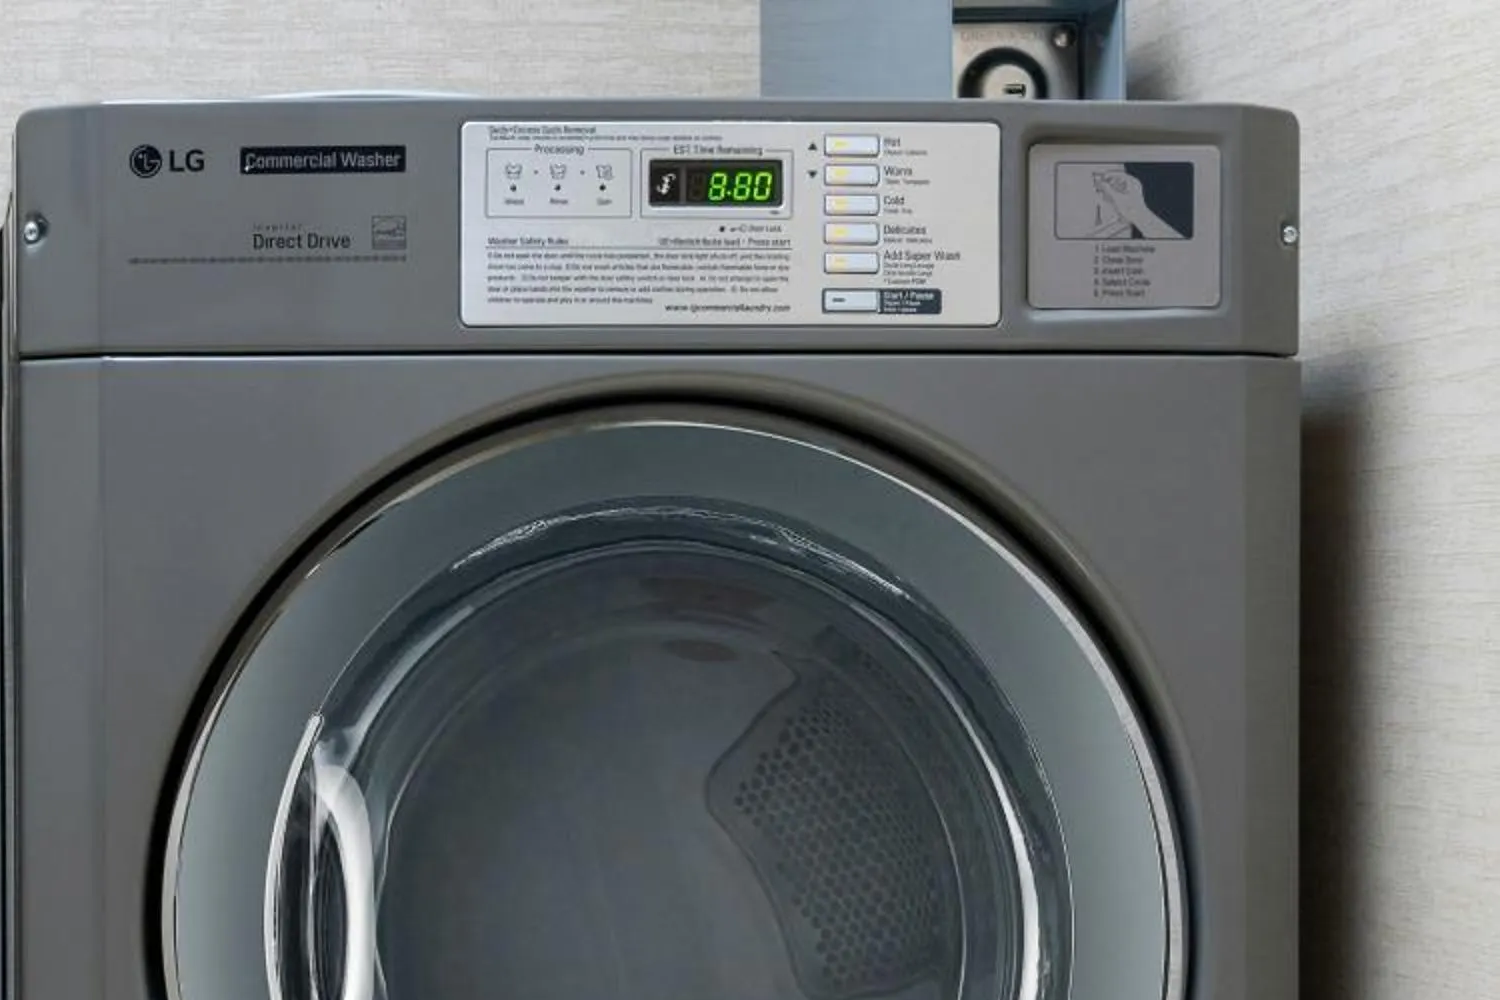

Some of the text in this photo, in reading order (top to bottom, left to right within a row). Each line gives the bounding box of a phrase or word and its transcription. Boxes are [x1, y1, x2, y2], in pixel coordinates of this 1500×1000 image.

[534, 144, 584, 156] Processing
[170, 150, 205, 173] LG
[245, 151, 401, 171] Commercial Washer
[884, 166, 913, 176] Warm
[884, 196, 905, 205] Cold
[253, 232, 351, 250] Direct Drive
[884, 251, 903, 260] Add
[904, 251, 931, 262] Super
